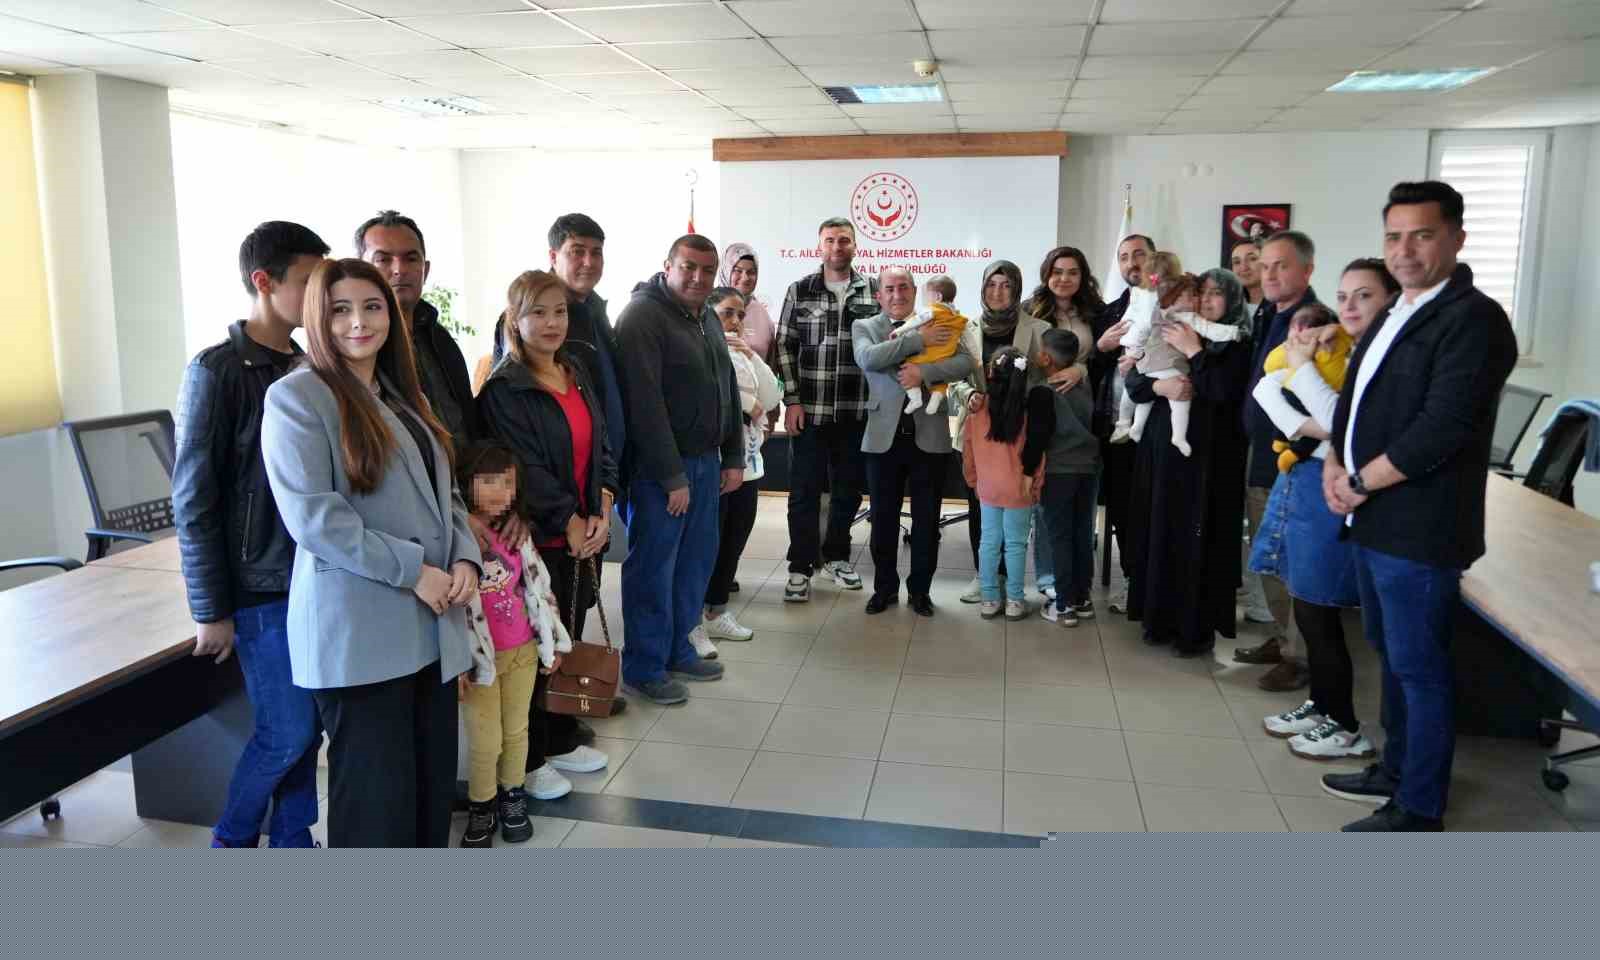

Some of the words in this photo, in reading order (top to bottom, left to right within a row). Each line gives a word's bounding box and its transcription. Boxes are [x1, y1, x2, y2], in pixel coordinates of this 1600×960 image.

[780, 249, 798, 258] T.C.
[799, 247, 821, 258] AİLE
[877, 247, 933, 258] HİZMETLER
[936, 247, 992, 258] BAKANLIĞI
[869, 263, 878, 274] İL
